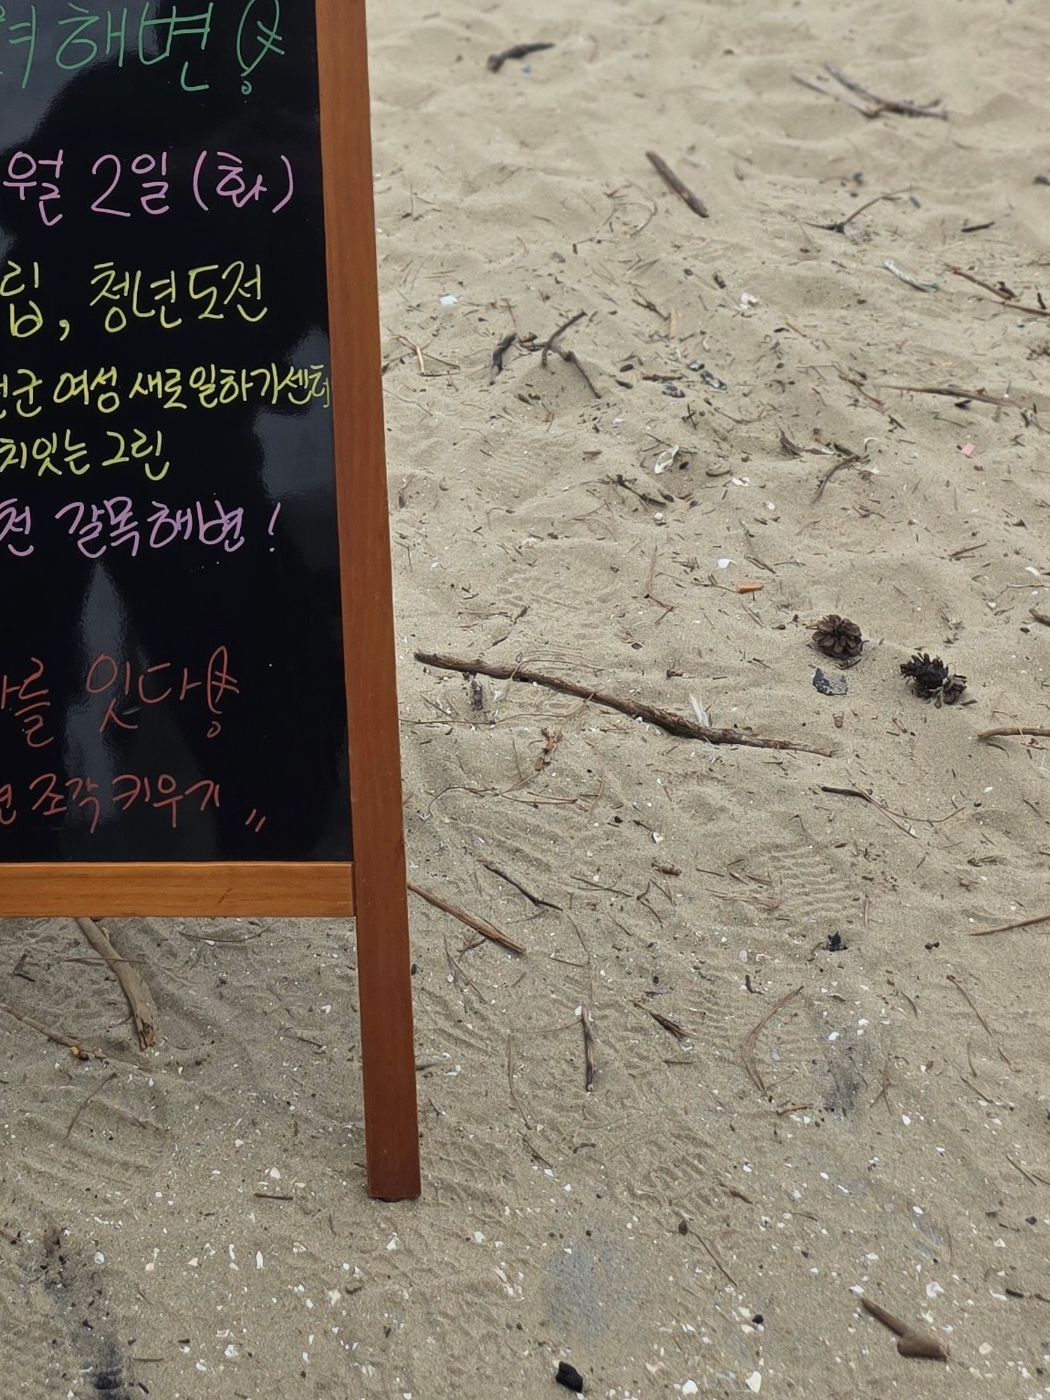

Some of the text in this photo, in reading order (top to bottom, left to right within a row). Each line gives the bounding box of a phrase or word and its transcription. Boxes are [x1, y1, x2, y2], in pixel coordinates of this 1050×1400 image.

[91, 151, 170, 217] 2일
[192, 150, 294, 214] (화)
[53, 365, 120, 413] 여성
[102, 428, 170, 481] 그린
